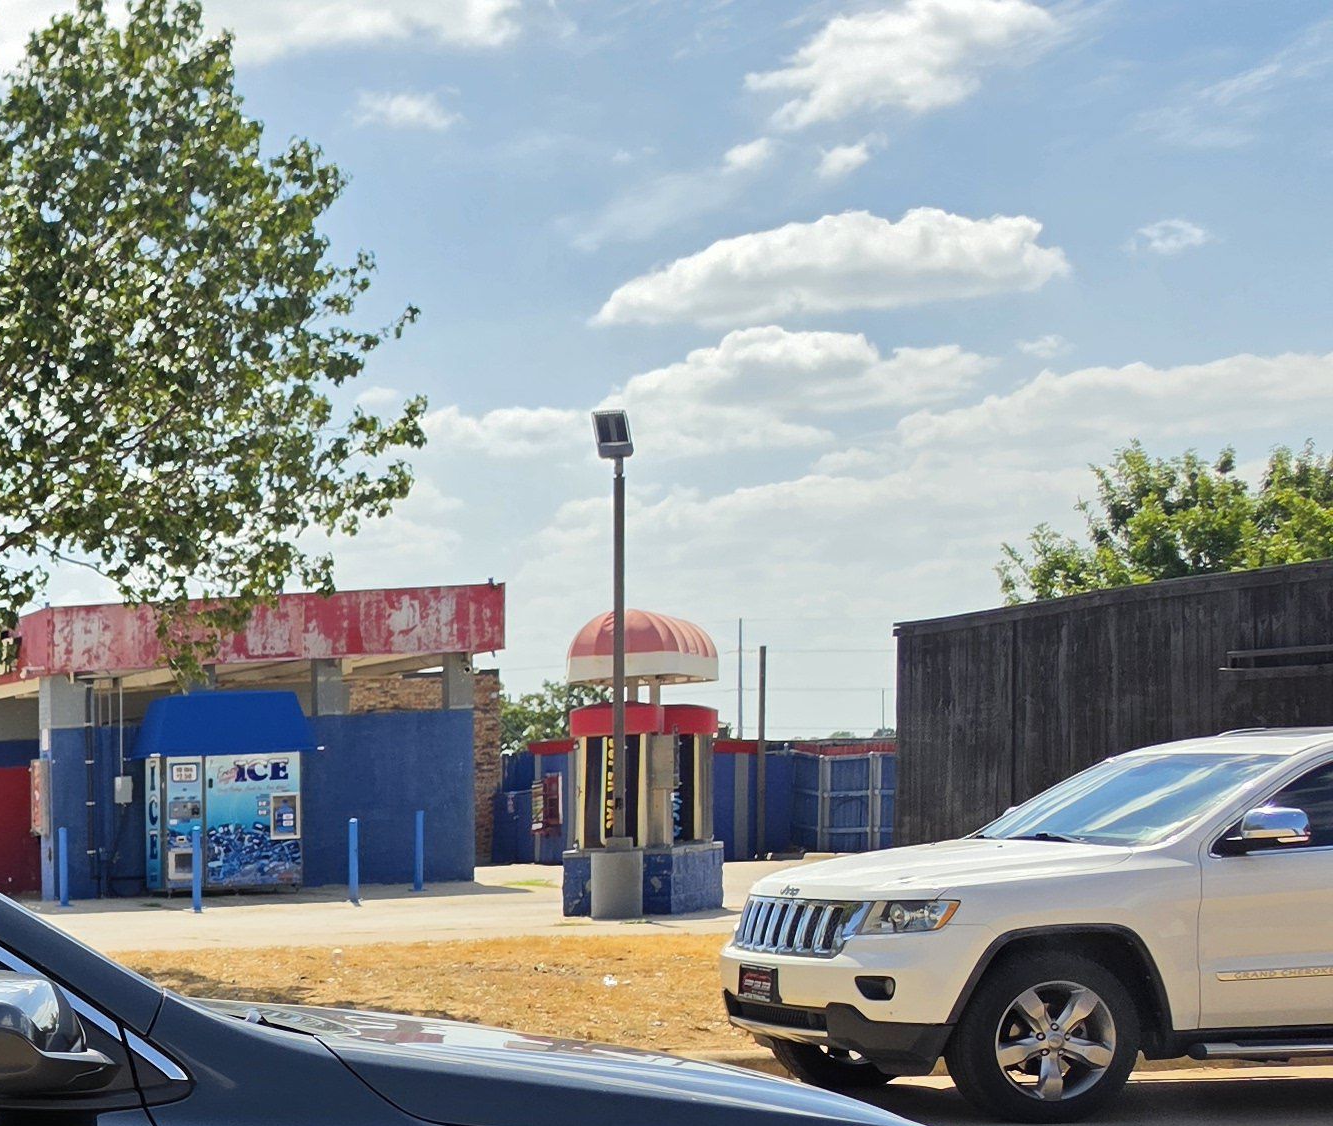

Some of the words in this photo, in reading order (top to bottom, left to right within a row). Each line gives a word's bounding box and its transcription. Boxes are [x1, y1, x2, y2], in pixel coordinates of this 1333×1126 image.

[234, 757, 289, 783] ICE
[148, 759, 159, 860] ICE
[1234, 970, 1277, 980] GRAND
